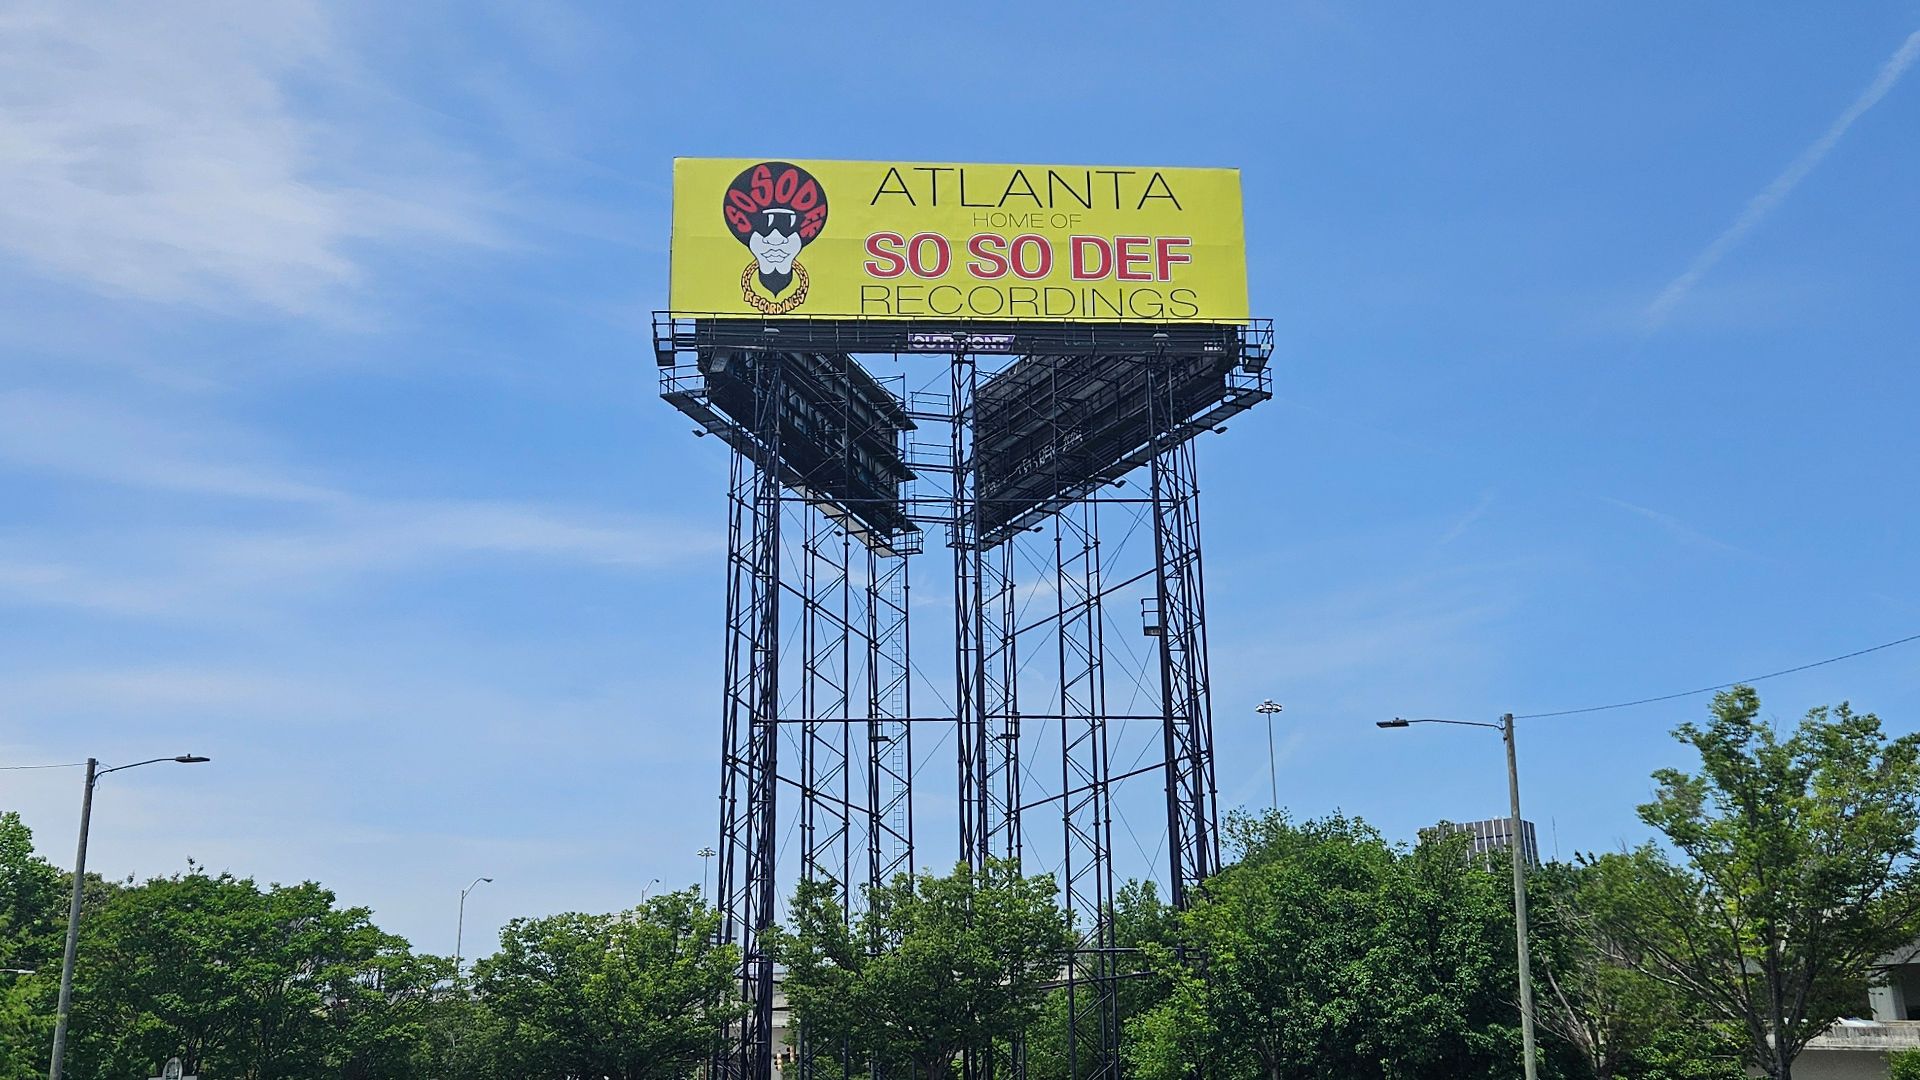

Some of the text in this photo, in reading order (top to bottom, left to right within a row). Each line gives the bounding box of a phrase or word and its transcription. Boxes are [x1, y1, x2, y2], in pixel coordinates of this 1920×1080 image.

[725, 164, 827, 238] SO SO DEF
[870, 167, 1183, 211] ATLANTA
[972, 212, 1082, 229] HOME OF
[864, 231, 1193, 282] SO SO DEF
[744, 290, 806, 314] RECORDINGS
[860, 285, 1200, 319] RECORDINGS
